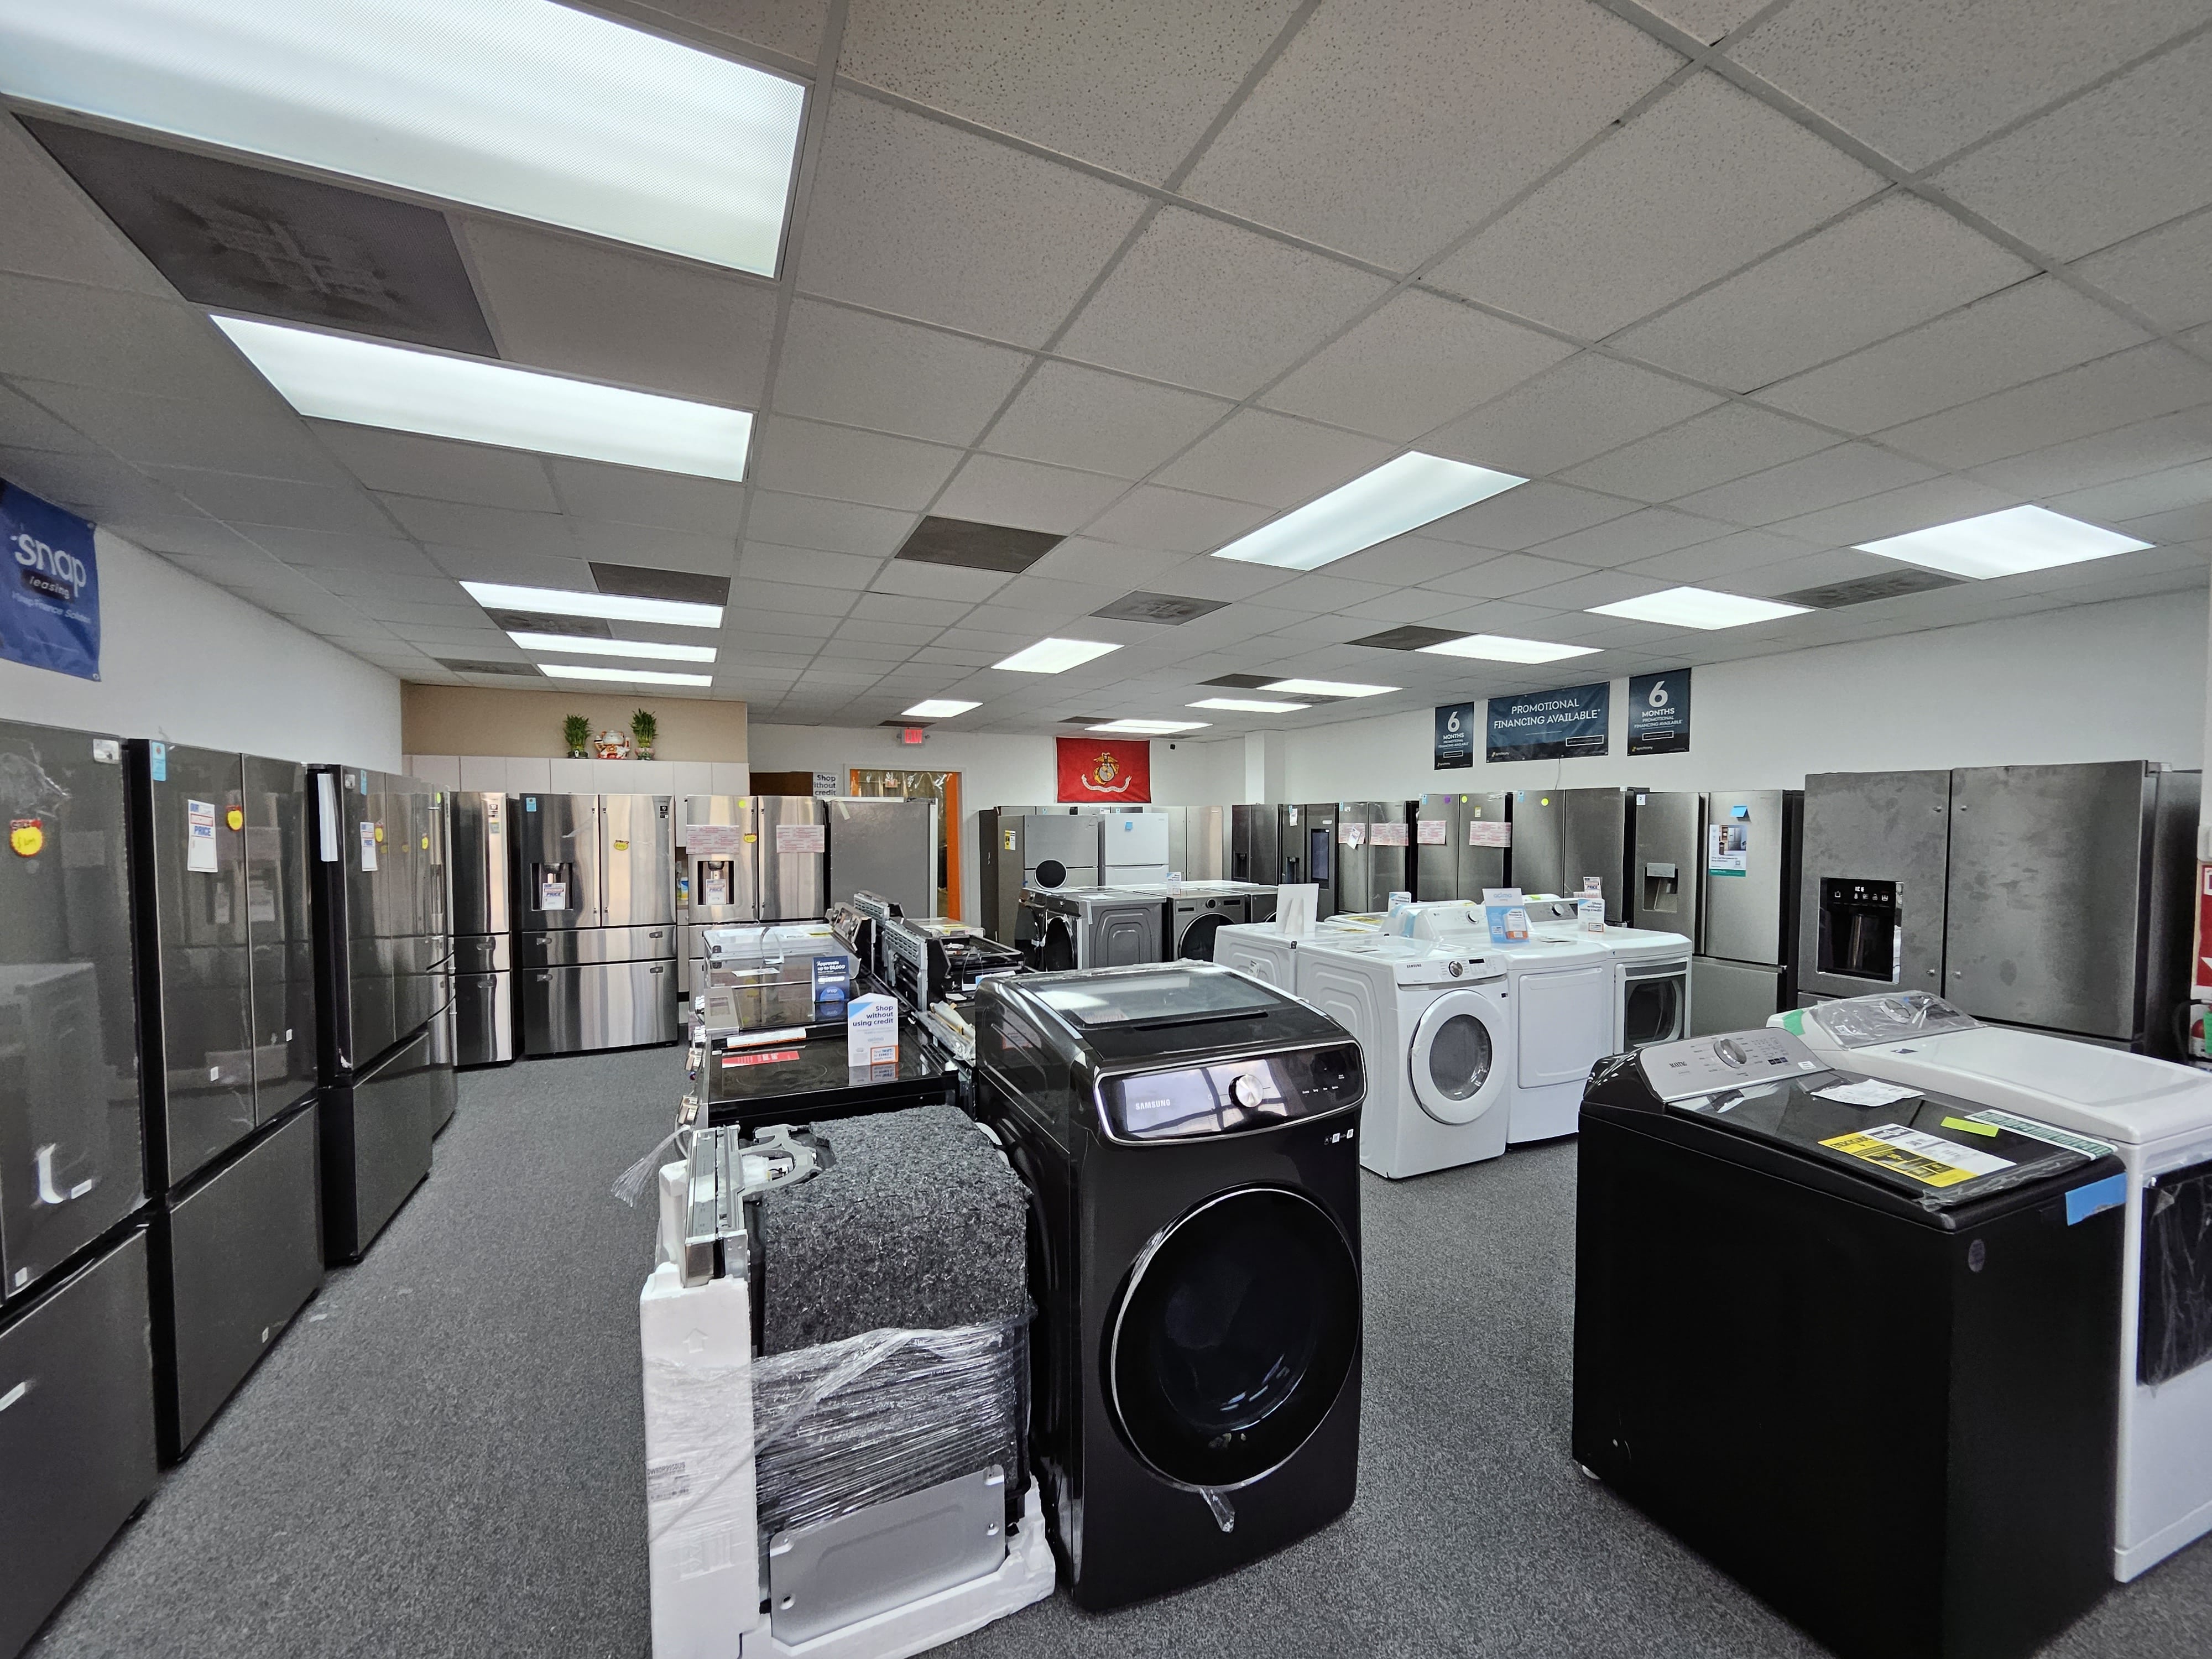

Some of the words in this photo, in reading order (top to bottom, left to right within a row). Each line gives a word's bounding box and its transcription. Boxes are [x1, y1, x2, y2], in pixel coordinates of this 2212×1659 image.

[15, 534, 87, 598] snap
[29, 576, 70, 599] leasing
[1649, 681, 1668, 707] 6
[1512, 698, 1580, 714] PROMOTIONAL
[1642, 708, 1675, 717] MONTHS
[1448, 711, 1460, 732] 6
[1494, 716, 1545, 729] FINANCING
[1135, 1099, 1171, 1110] SAMSUNG
